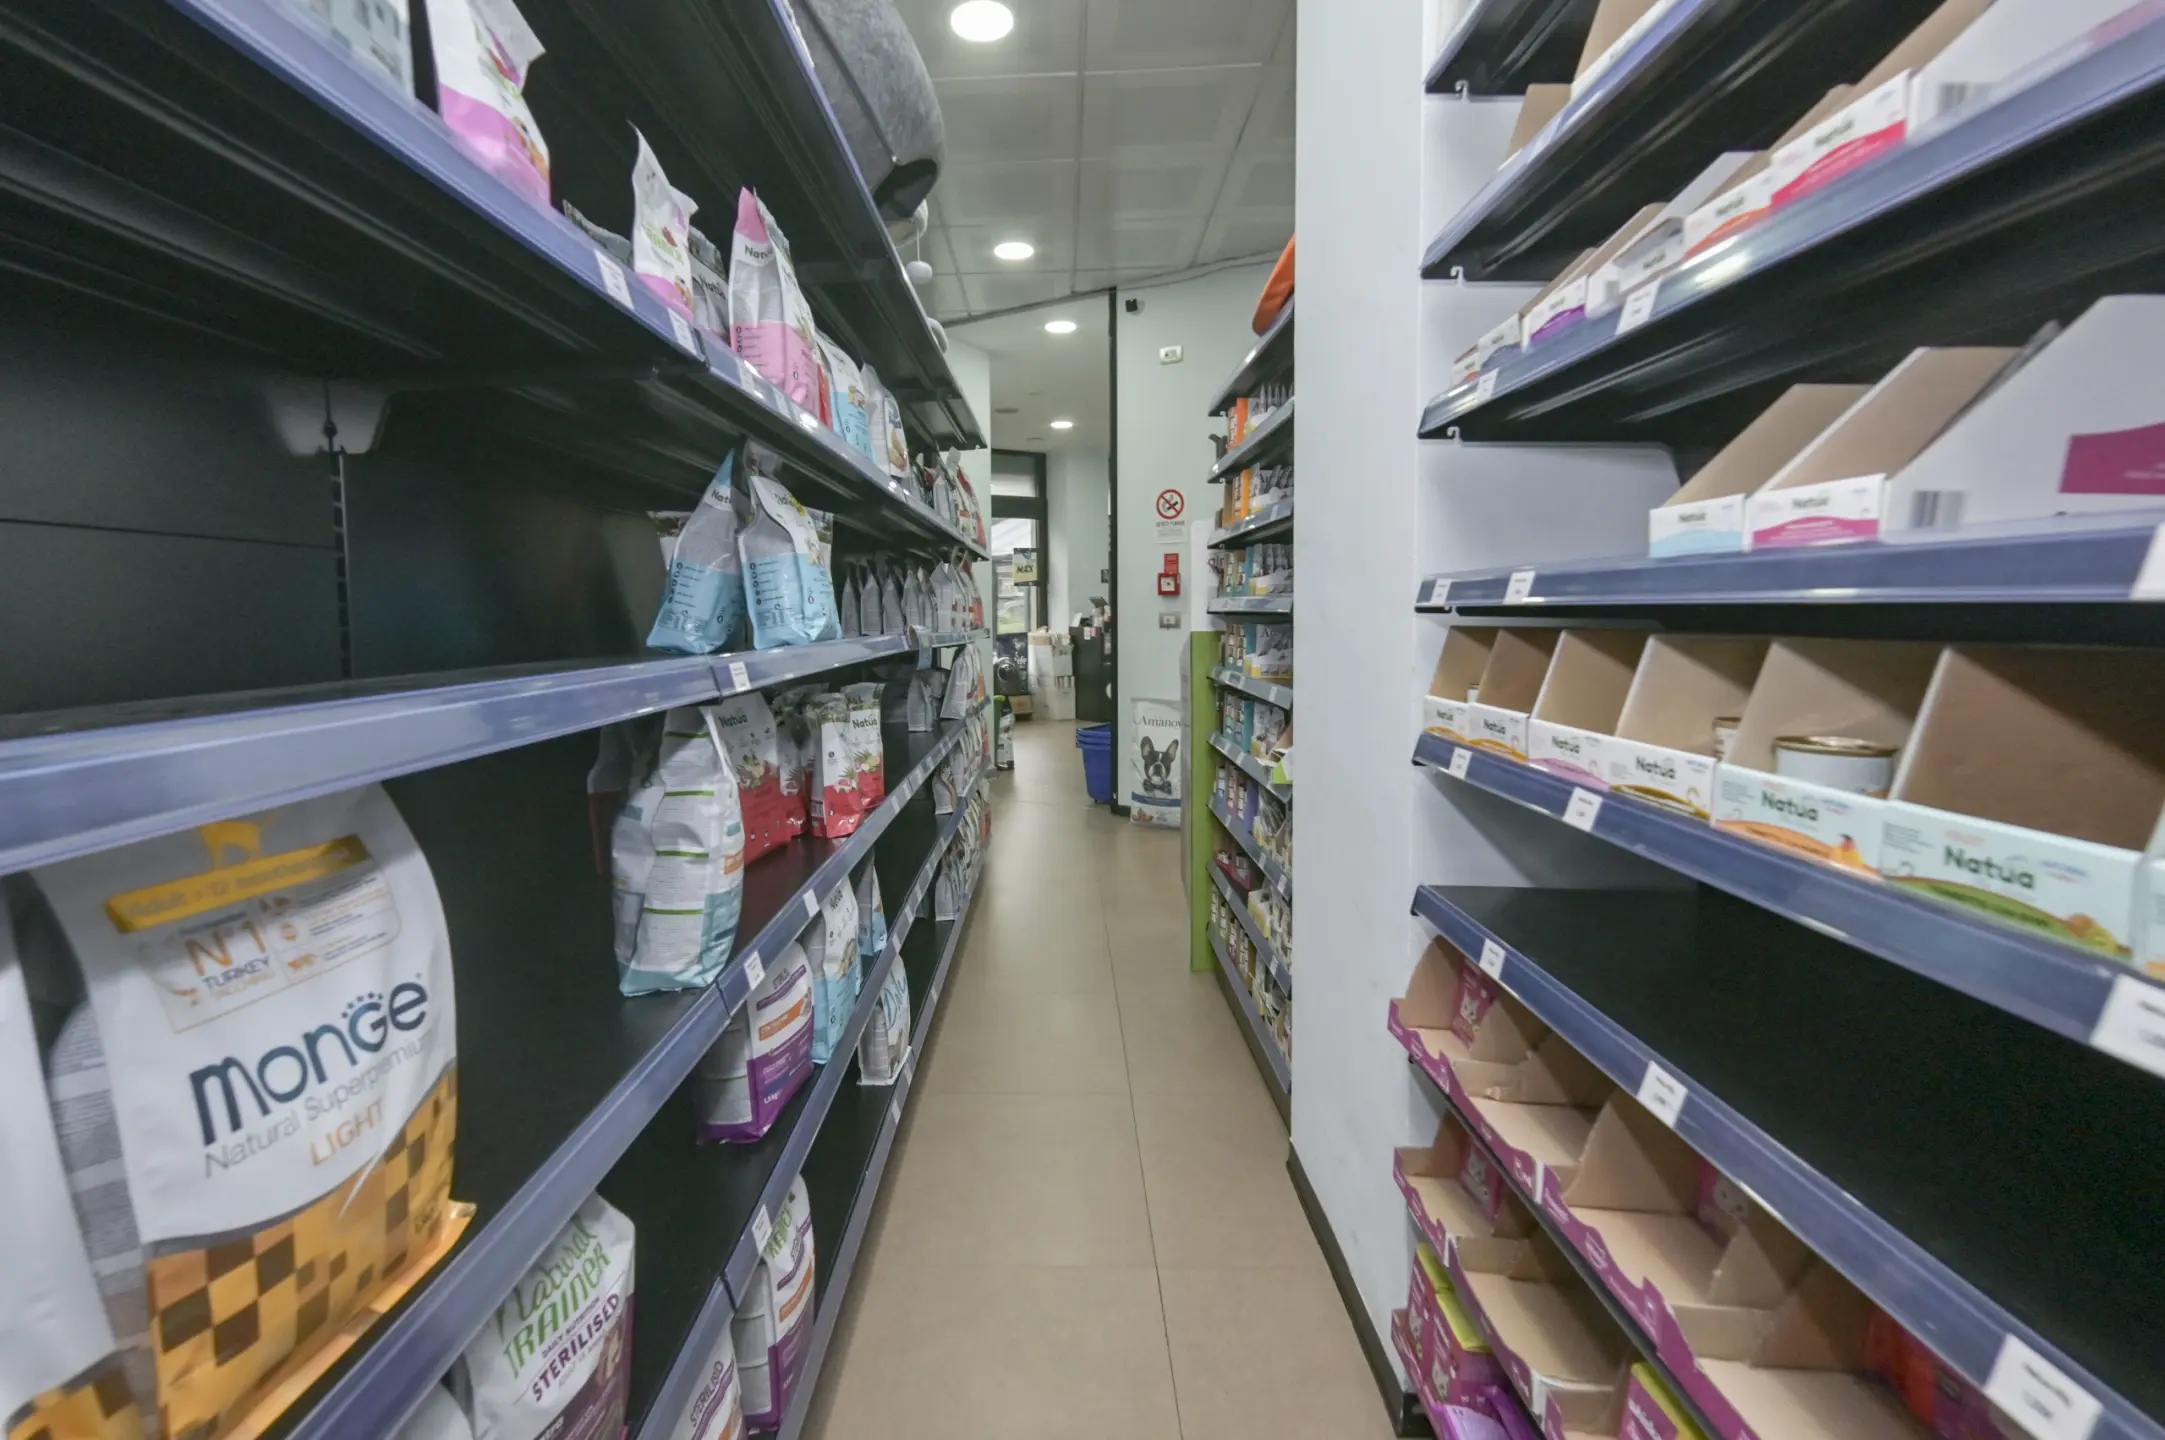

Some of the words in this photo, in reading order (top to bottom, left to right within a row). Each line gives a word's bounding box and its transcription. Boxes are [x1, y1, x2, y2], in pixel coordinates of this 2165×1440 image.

[851, 717, 878, 730] Natua
[1636, 755, 1676, 780] Natua
[1761, 791, 1820, 822] Natua
[1943, 846, 2036, 890] Natua
[204, 1107, 300, 1179] Natural
[310, 1096, 385, 1167] LIGHT
[532, 1292, 620, 1402] STERILISED
